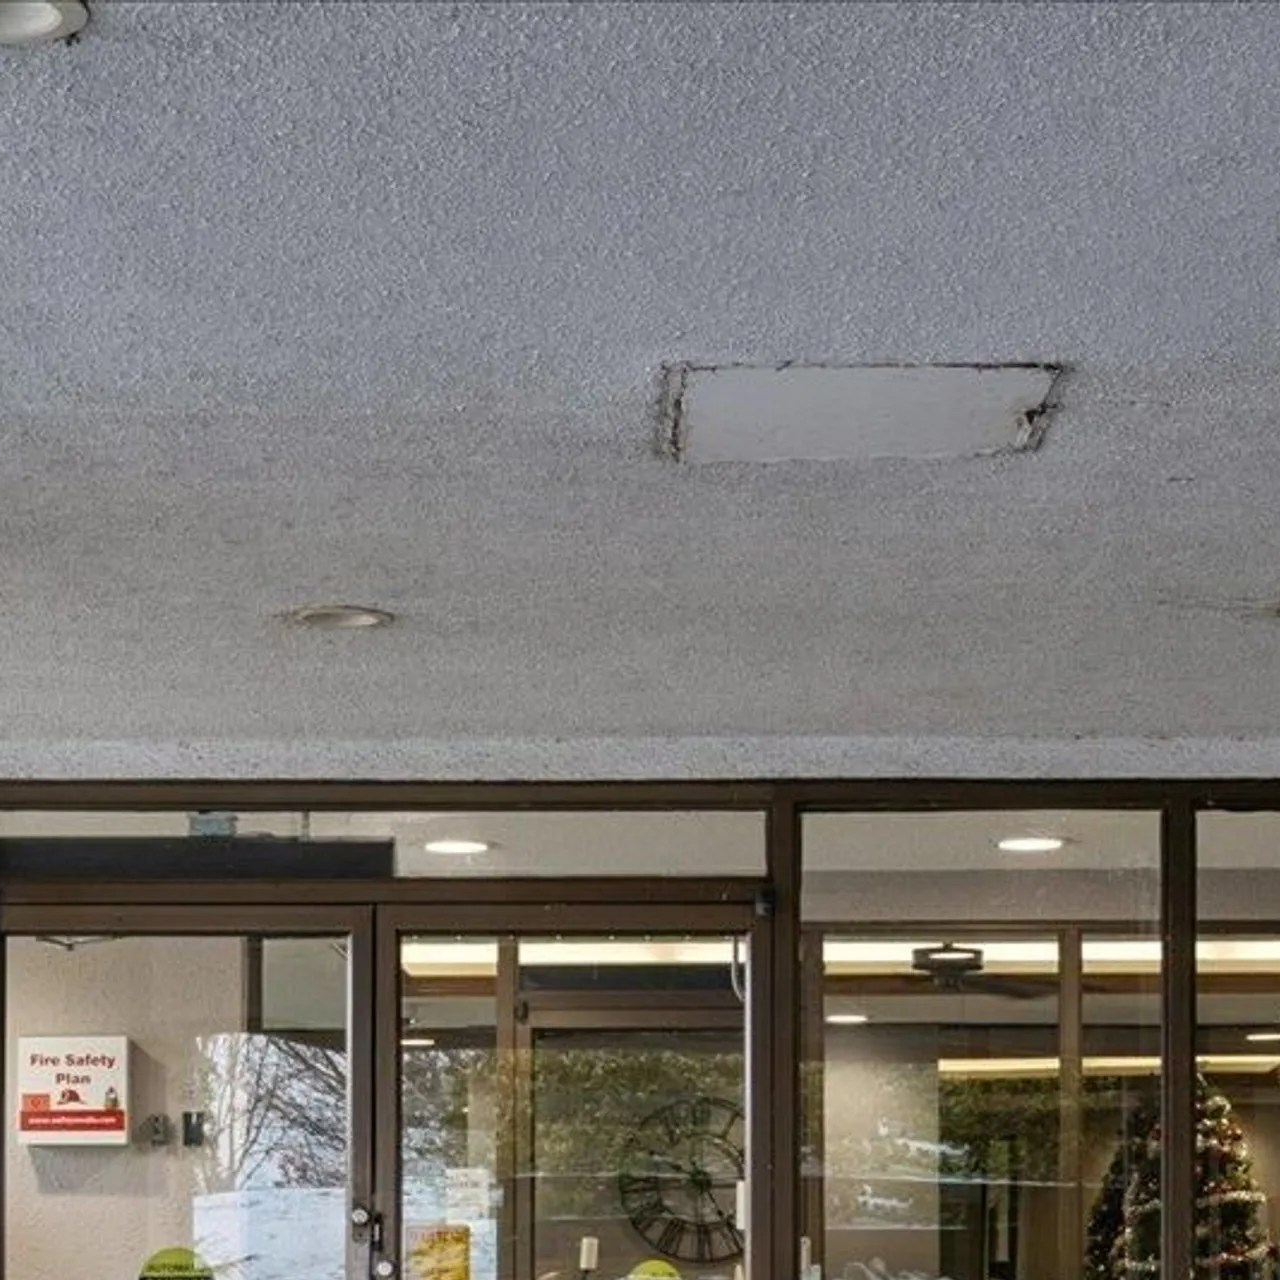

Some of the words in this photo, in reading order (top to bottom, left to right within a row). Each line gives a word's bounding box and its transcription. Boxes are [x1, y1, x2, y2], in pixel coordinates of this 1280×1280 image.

[30, 1054, 60, 1067] Fire
[64, 1054, 116, 1069] Safety
[55, 1073, 91, 1085] Plan
